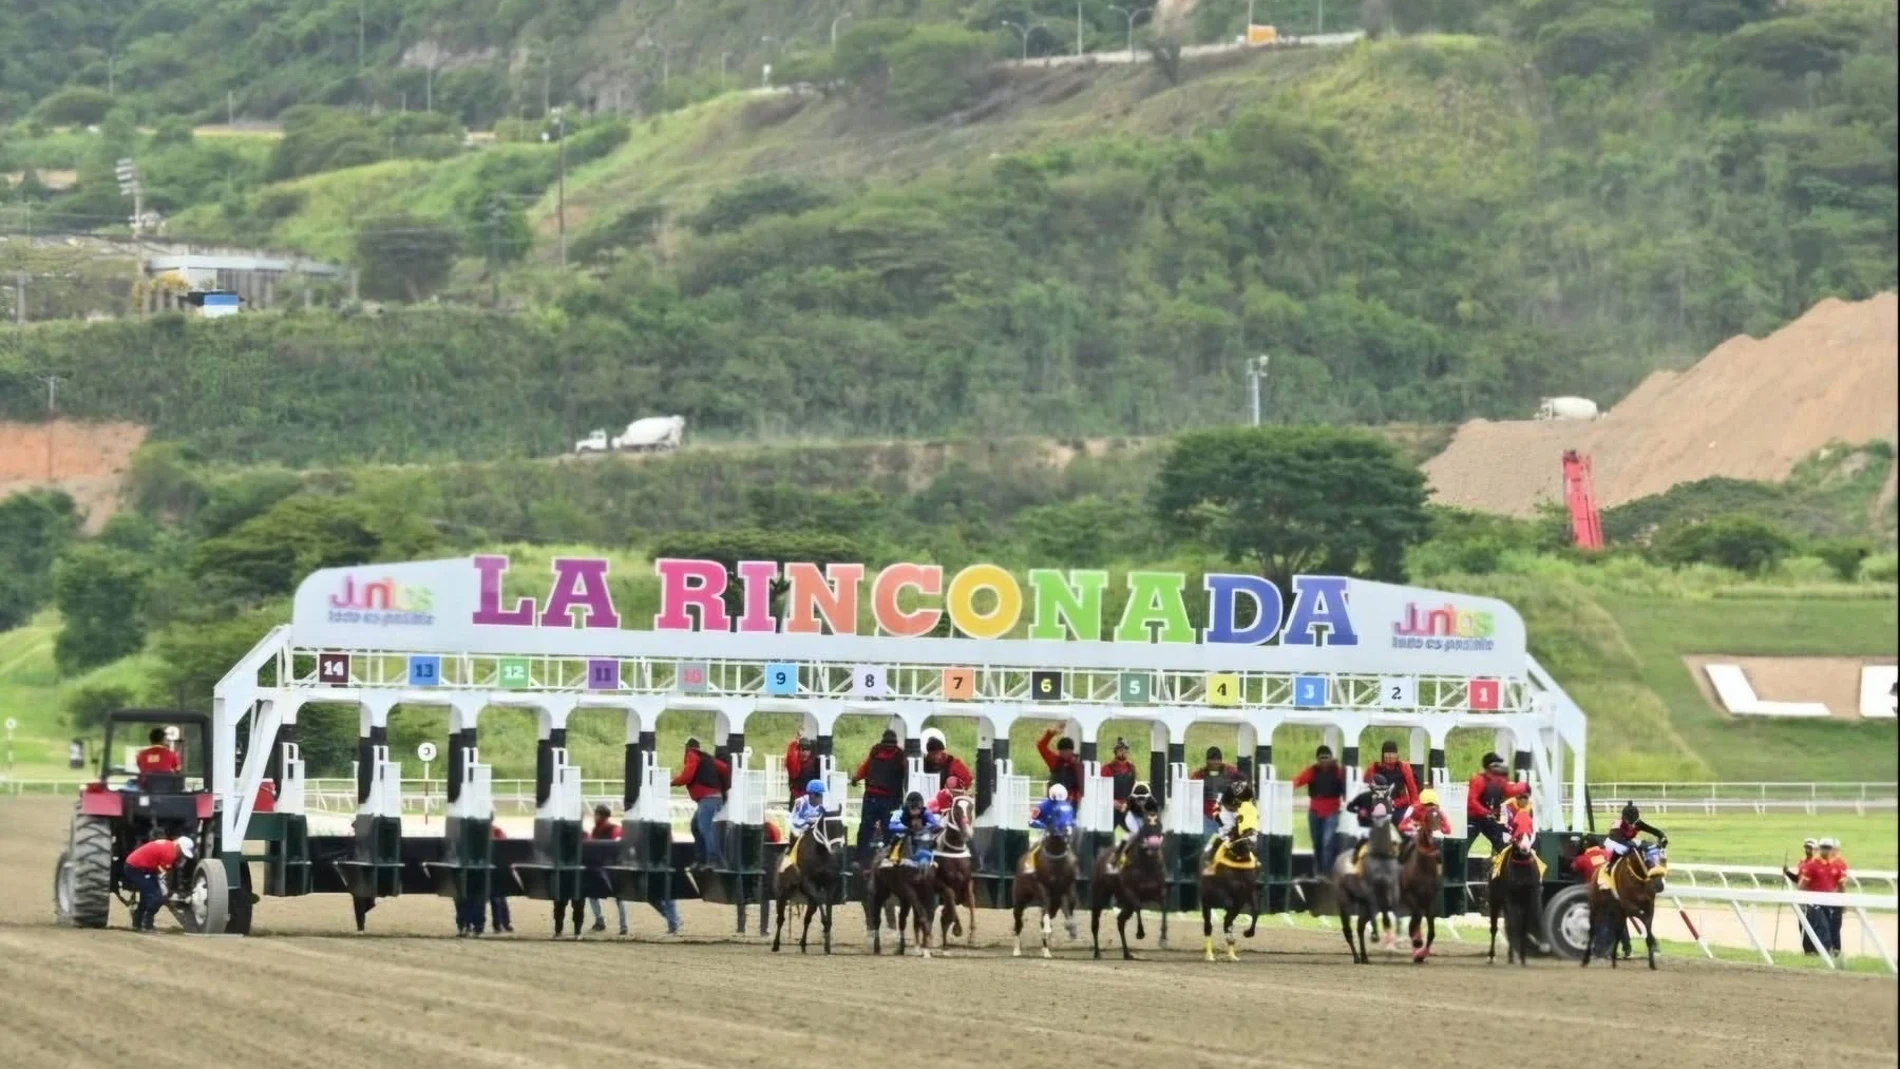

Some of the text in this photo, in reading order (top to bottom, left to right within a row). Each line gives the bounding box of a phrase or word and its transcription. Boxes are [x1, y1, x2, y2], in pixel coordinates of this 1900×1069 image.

[472, 555, 1359, 647] LA RINCONADA
[324, 660, 344, 676] 14
[415, 663, 434, 677] 13
[504, 665, 525, 679] 12
[595, 667, 612, 681] 11
[683, 668, 704, 684] 10
[776, 671, 787, 685] 9
[865, 674, 875, 688] 8
[953, 676, 964, 690] 7
[1040, 677, 1052, 693] 6
[1129, 679, 1141, 695] 5
[1217, 682, 1228, 697] 4
[1303, 683, 1315, 699] 3
[1391, 686, 1402, 700] 2
[1479, 687, 1489, 702] 1
